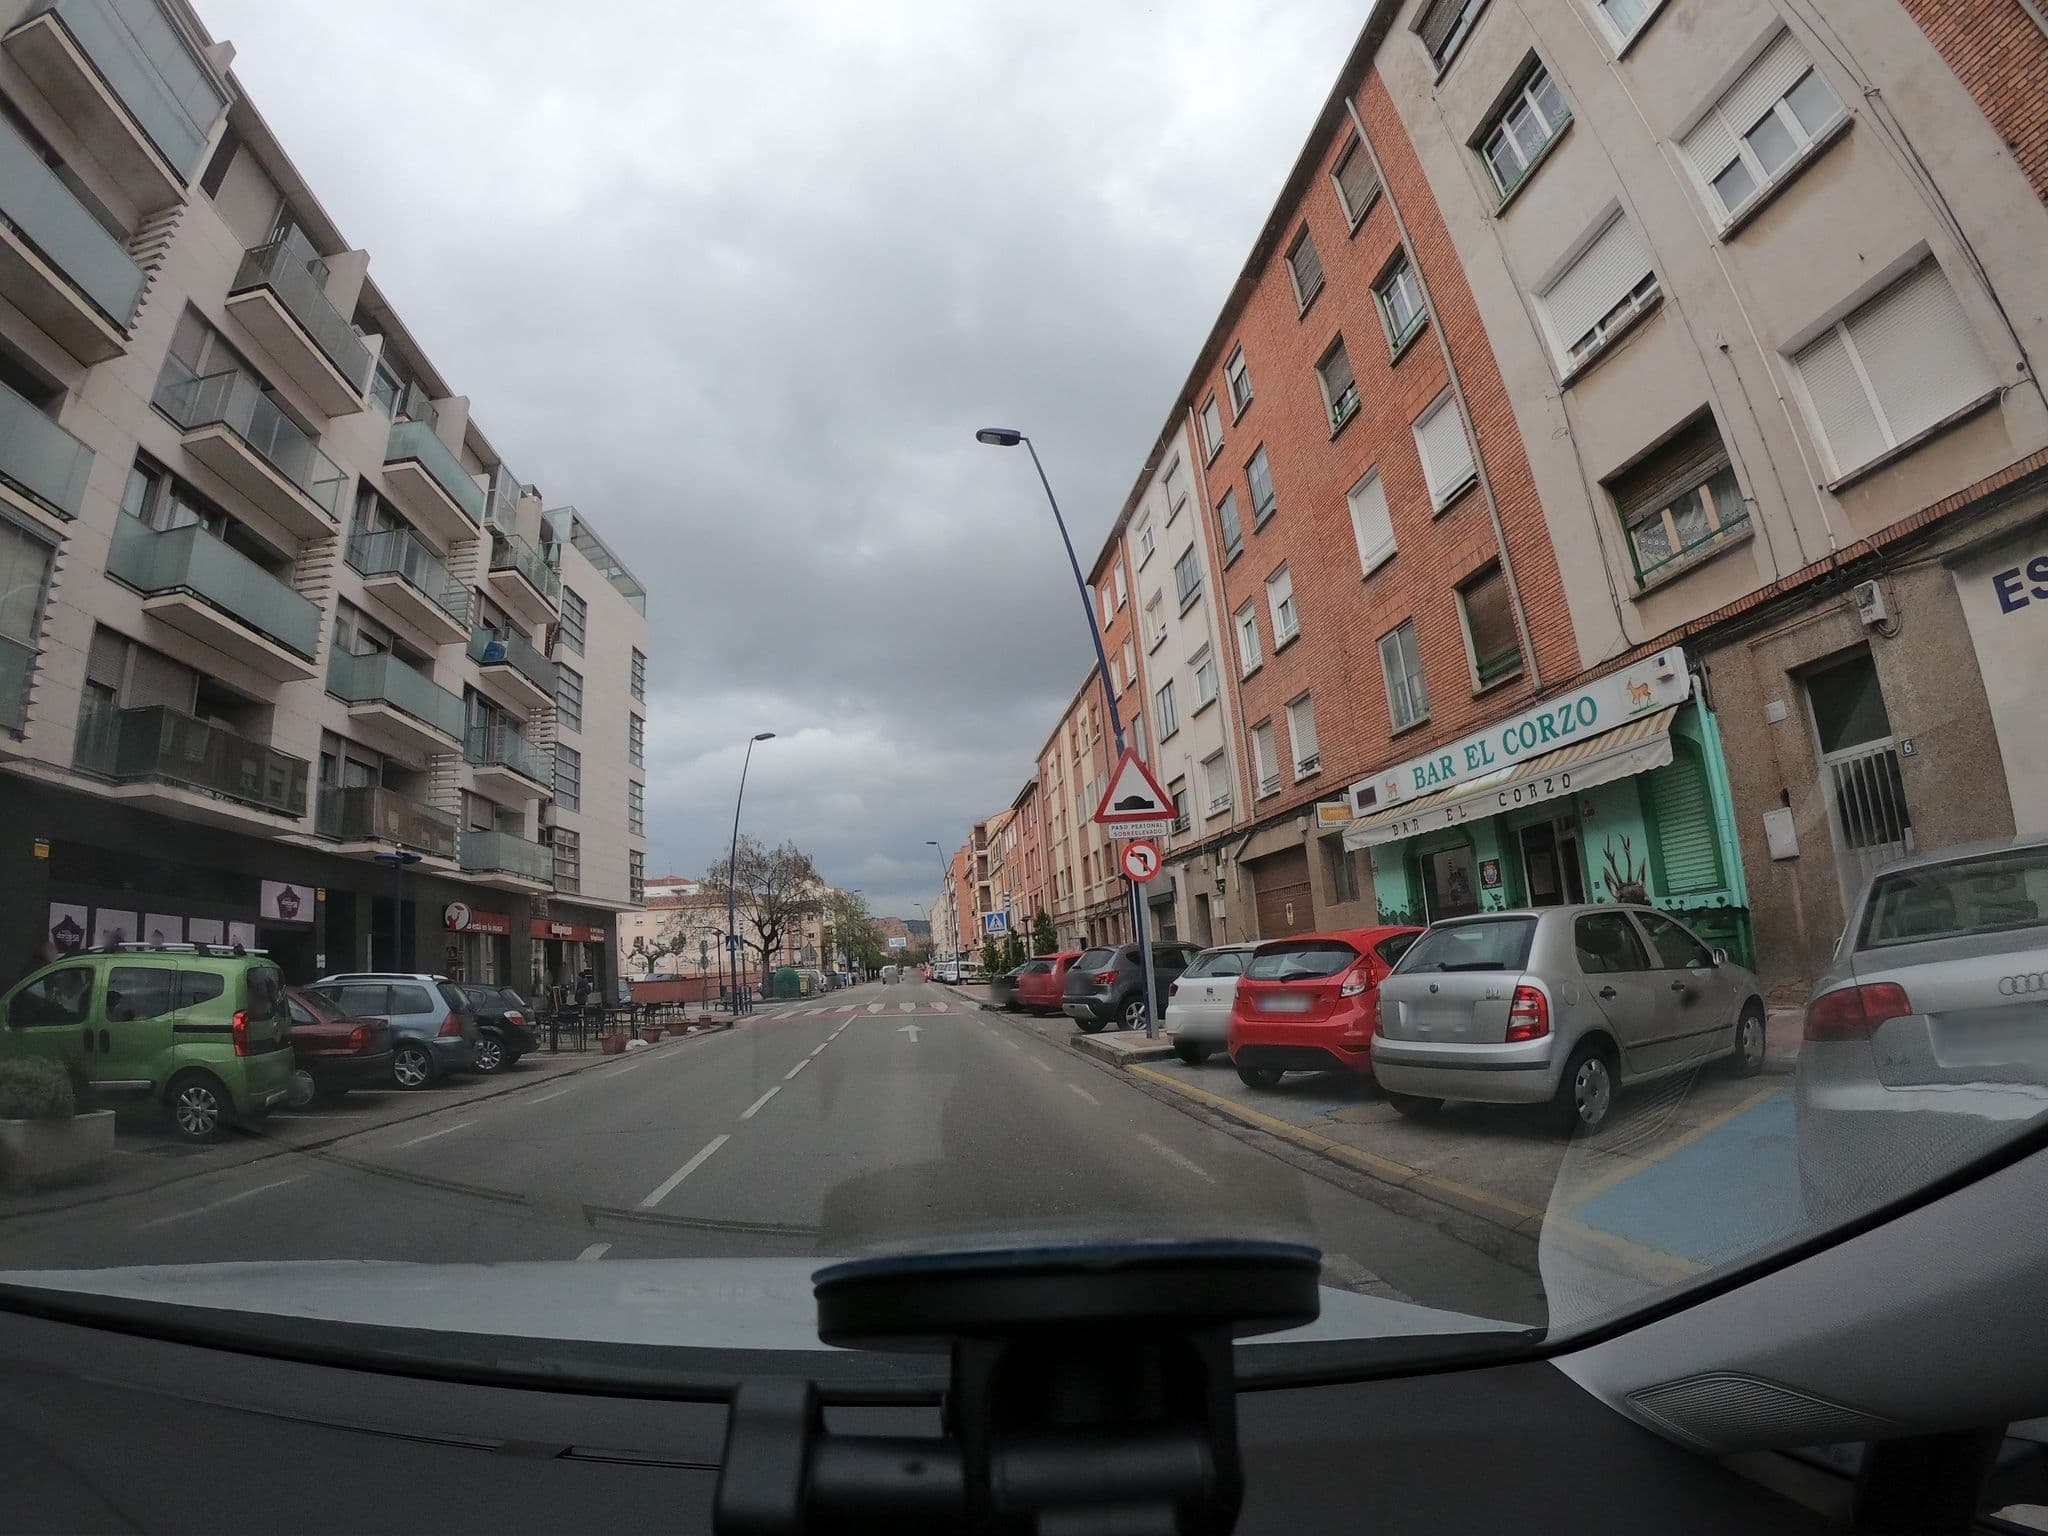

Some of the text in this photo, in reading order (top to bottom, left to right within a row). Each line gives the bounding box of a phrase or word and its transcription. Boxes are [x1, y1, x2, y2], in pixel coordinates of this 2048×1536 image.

[1412, 696, 1598, 790] BAR EL CORZO
[1903, 740, 1913, 753] 6
[1391, 773, 1572, 837] BAR EL CORZO
[1131, 822, 1163, 830] PEATONAL
[1113, 829, 1163, 838] SOBREELEVADO
